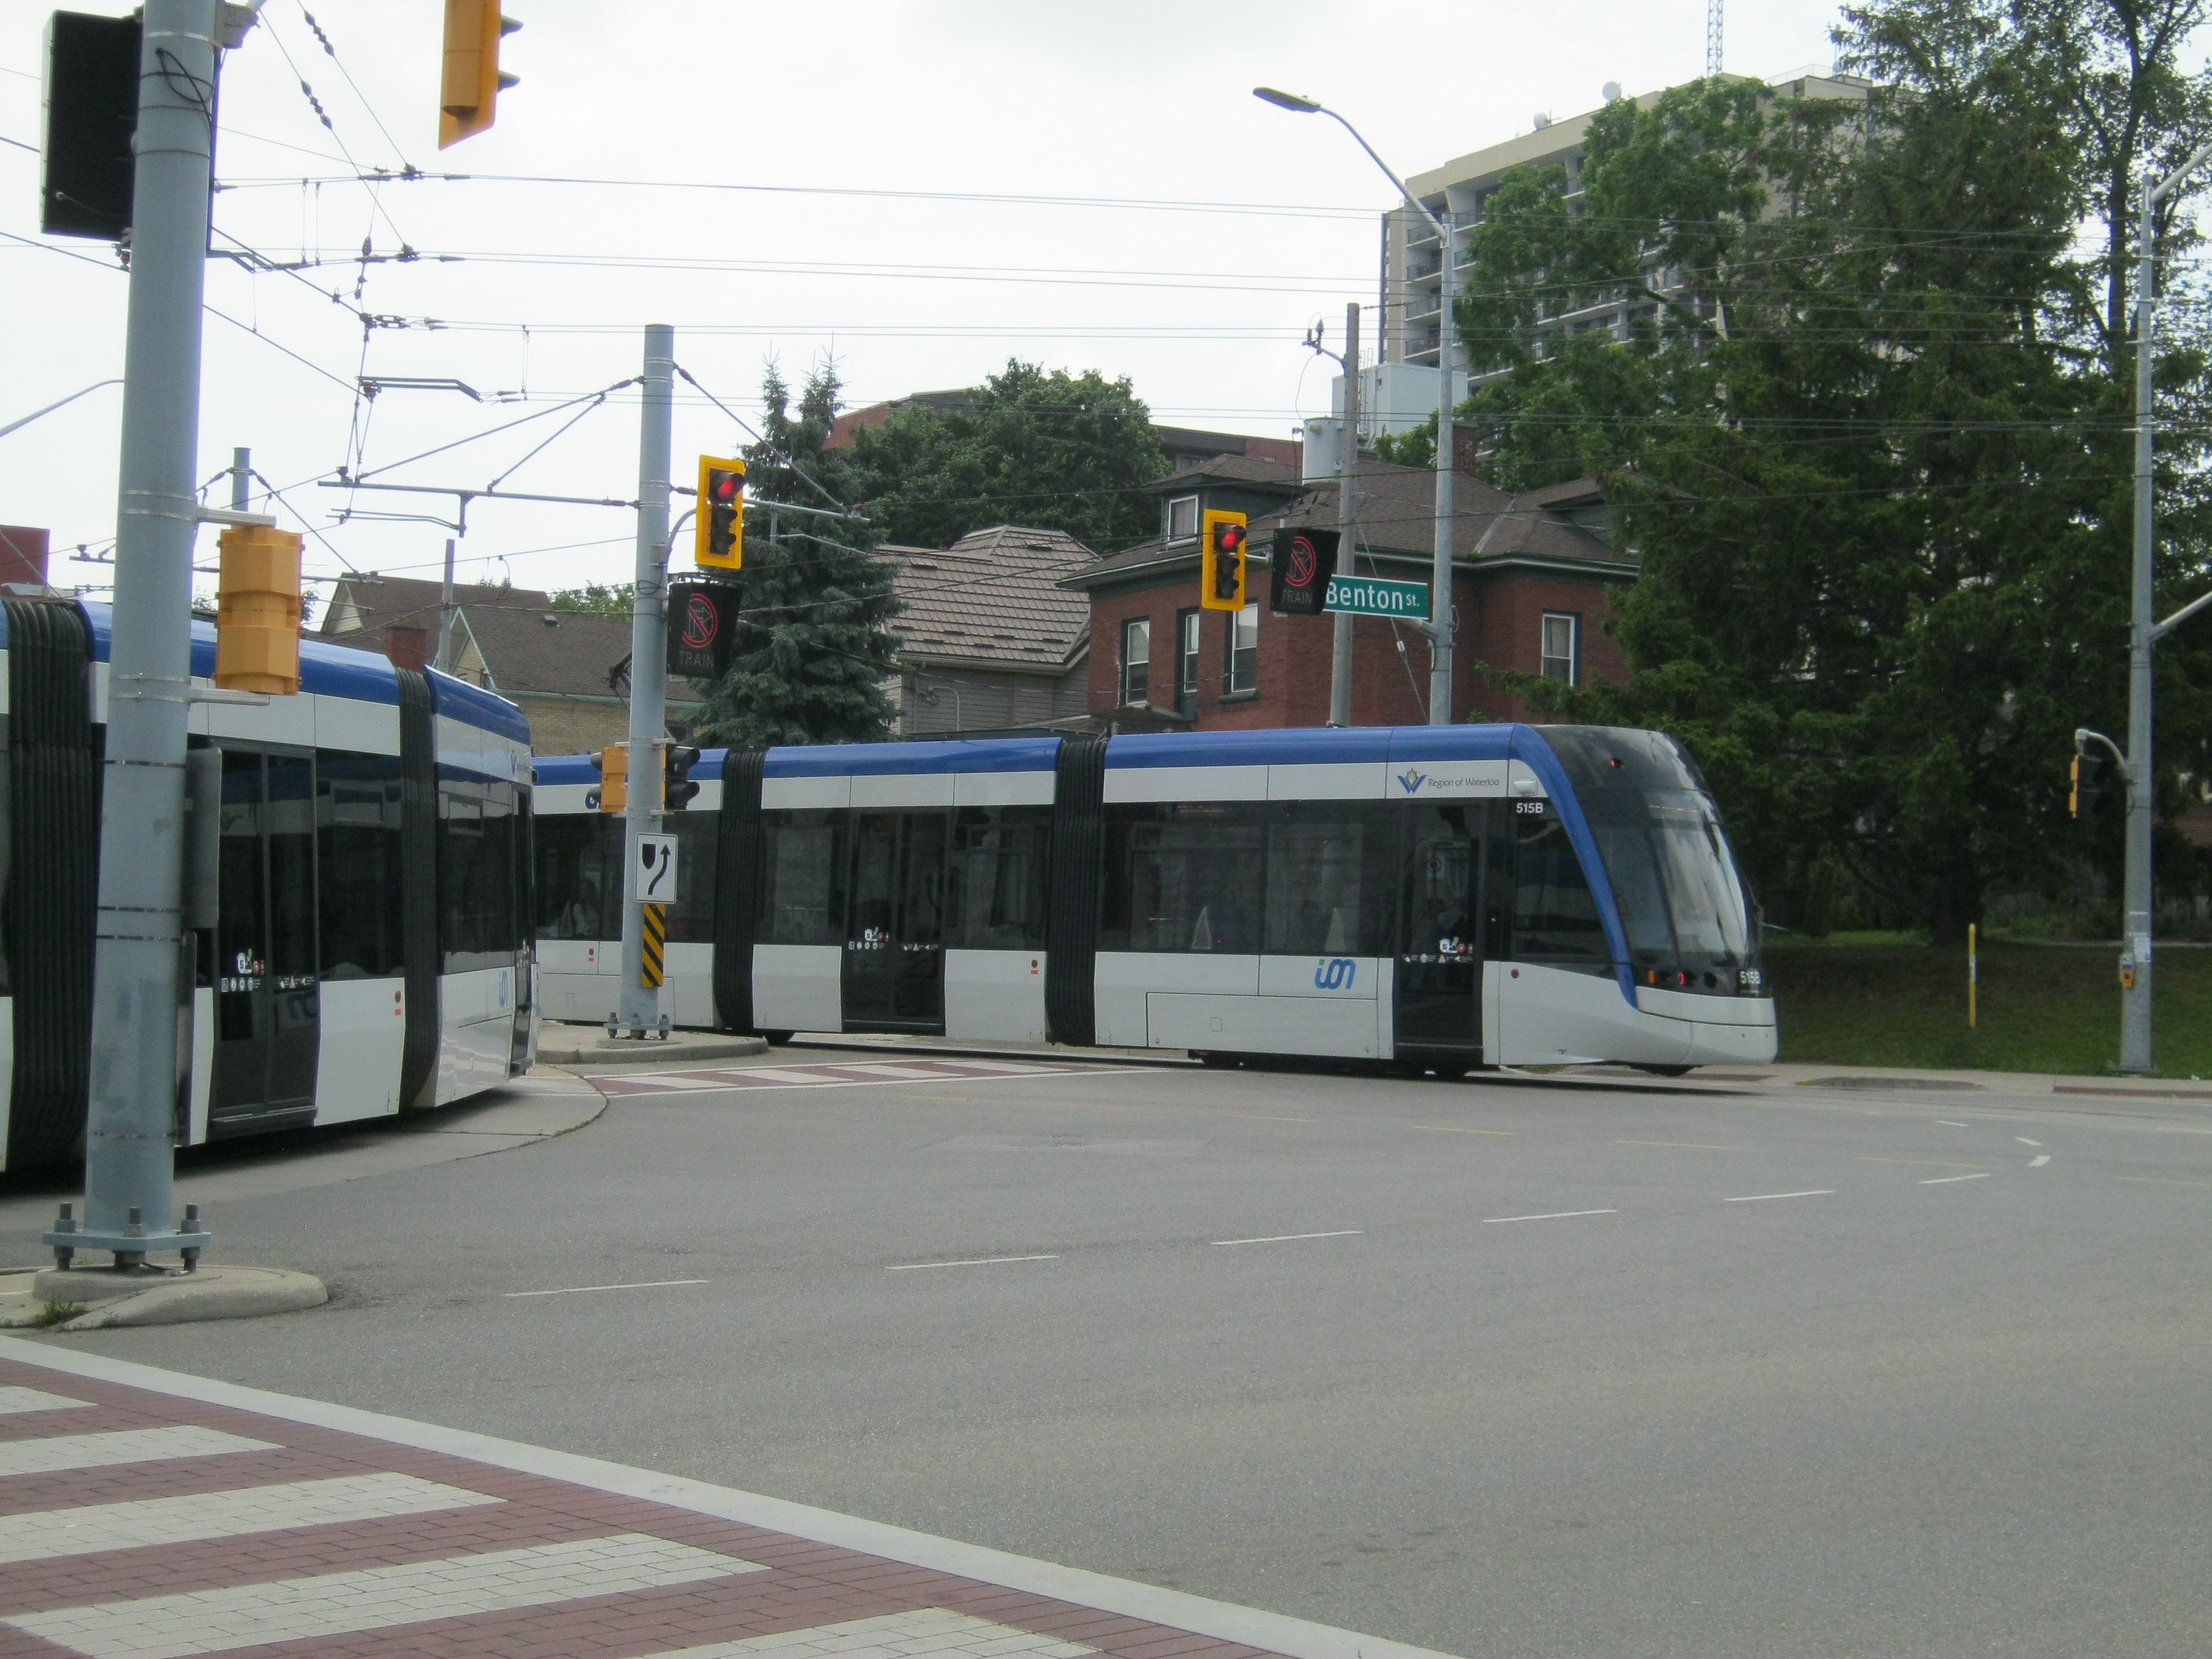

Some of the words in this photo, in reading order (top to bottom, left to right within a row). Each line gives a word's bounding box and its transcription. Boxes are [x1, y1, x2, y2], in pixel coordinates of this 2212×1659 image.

[1281, 589, 1312, 605] TRAIN
[1326, 581, 1403, 610] Benton
[1406, 594, 1420, 607] St.
[679, 651, 714, 668] TRAIN
[1428, 779, 1454, 789] Region
[1455, 777, 1466, 786] of
[1466, 777, 1500, 786] Waterloo
[1516, 802, 1544, 813] 515B
